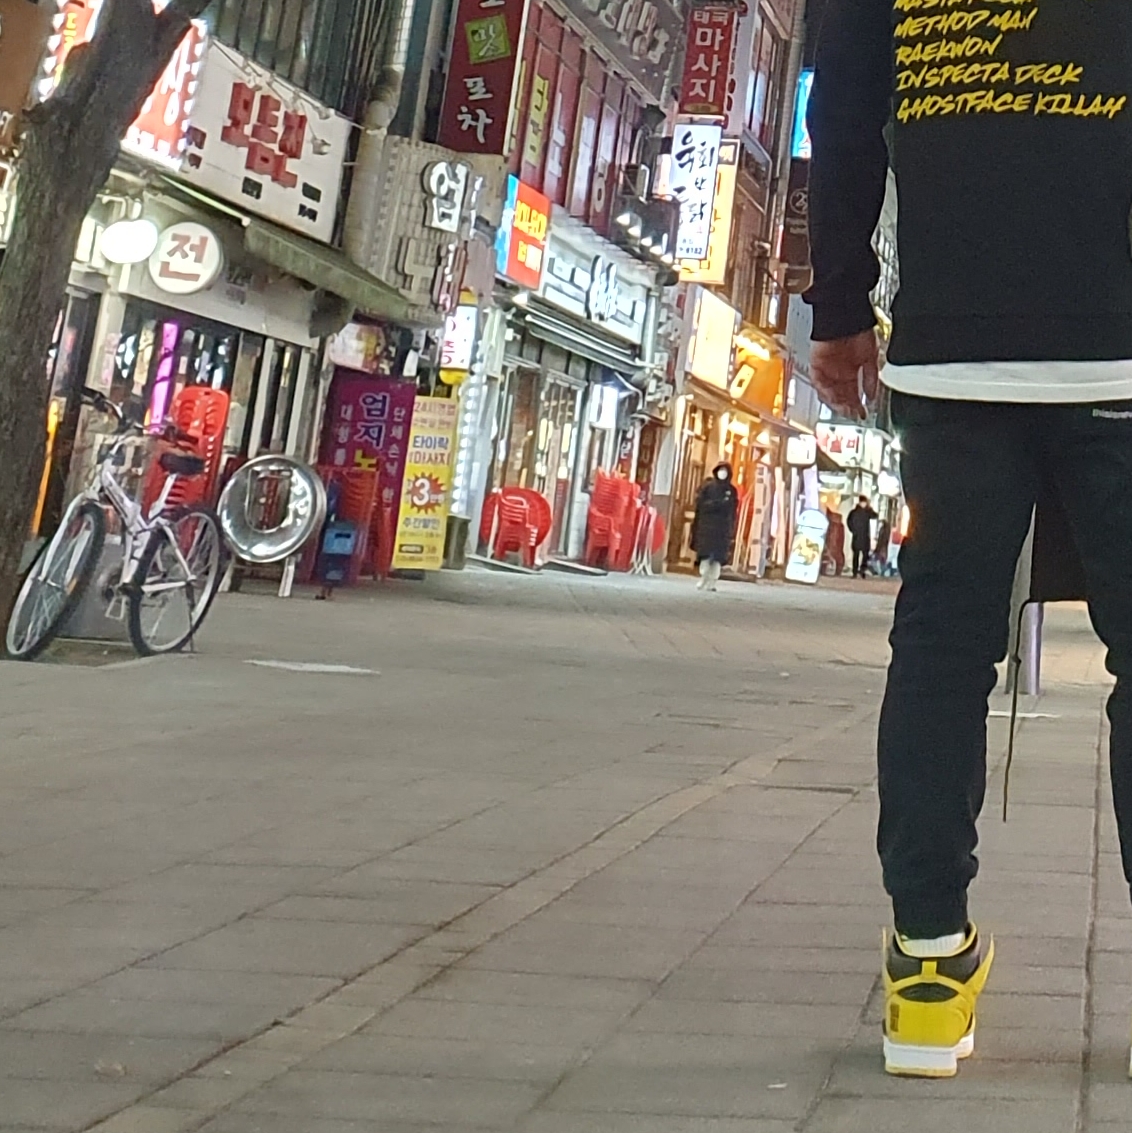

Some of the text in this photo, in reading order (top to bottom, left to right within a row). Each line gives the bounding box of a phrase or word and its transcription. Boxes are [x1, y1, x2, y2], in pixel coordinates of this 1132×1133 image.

[894, 7, 1038, 37] METHOD MAN
[896, 34, 1003, 65] RAEKWON
[688, 29, 725, 103] 마사지
[896, 62, 1083, 91] INSPECTA DECK
[897, 89, 1126, 123] GHOSTFACE KILLAH
[159, 232, 208, 282] 전
